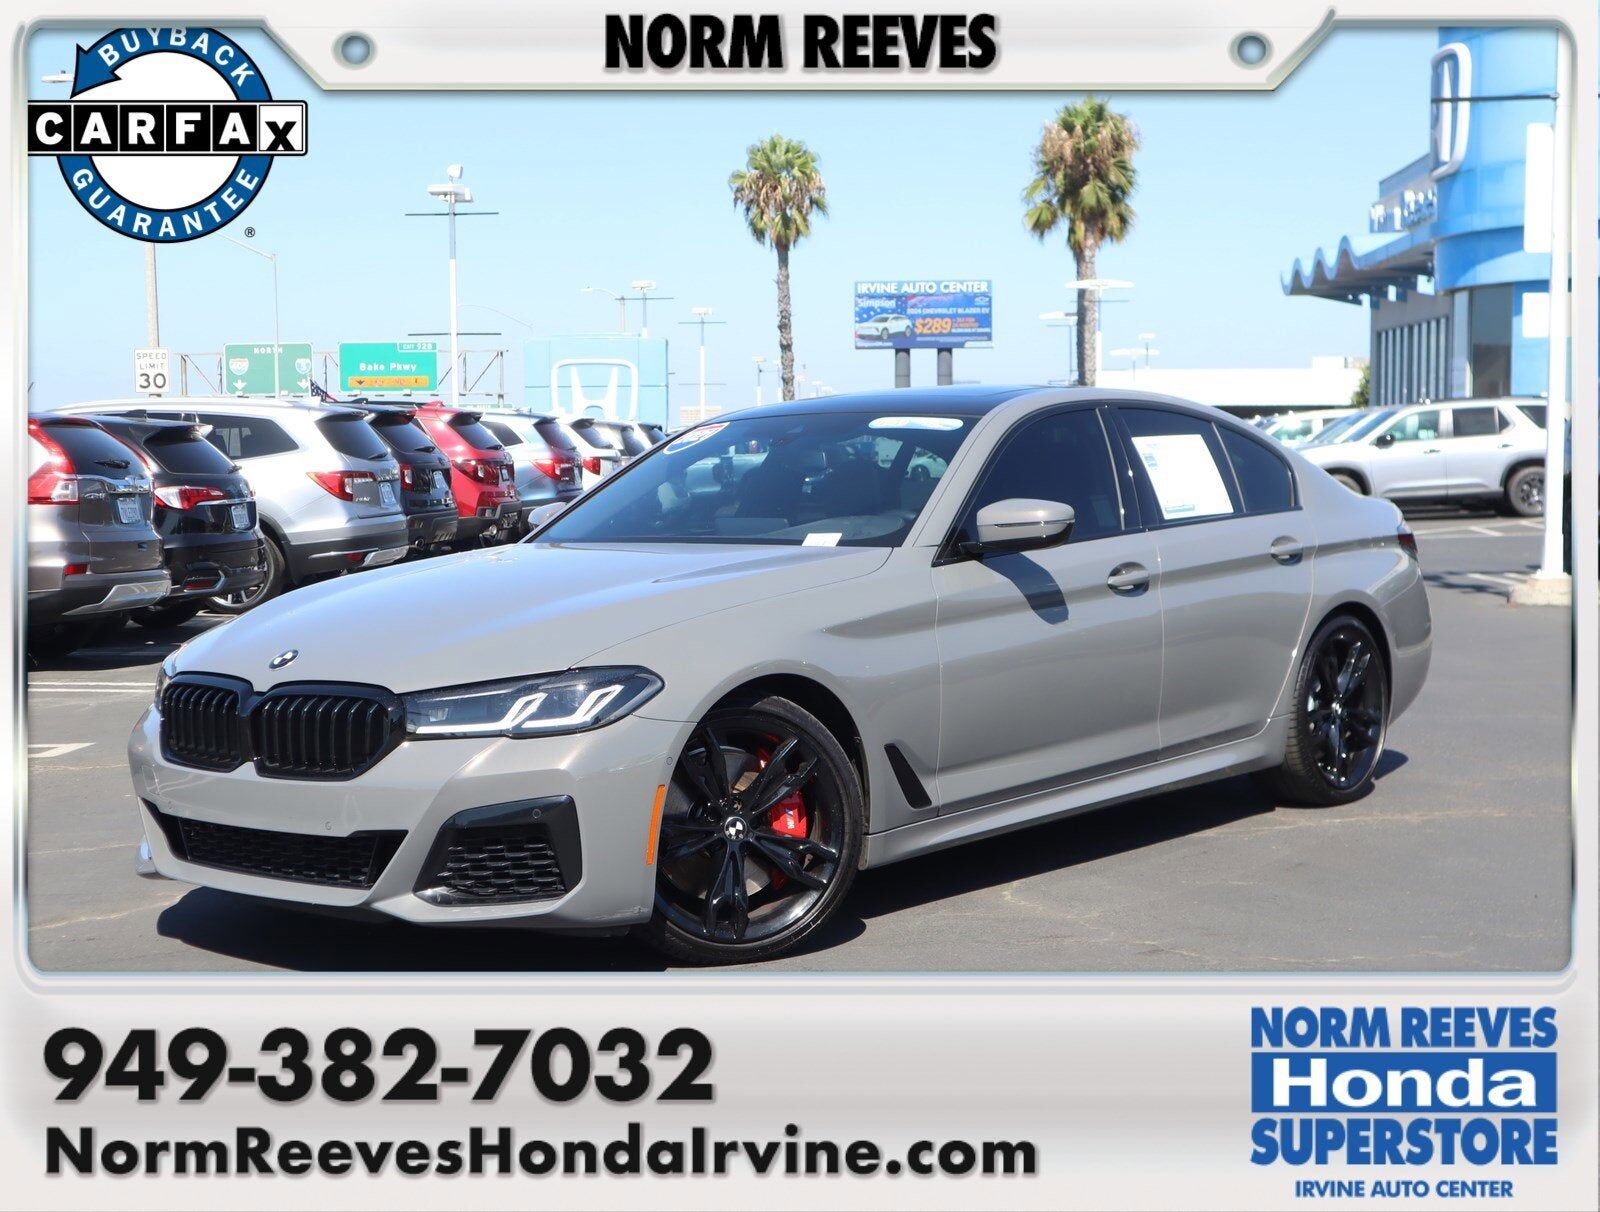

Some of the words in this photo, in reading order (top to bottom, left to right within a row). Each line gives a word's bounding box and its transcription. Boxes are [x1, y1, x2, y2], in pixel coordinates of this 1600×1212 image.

[857, 282, 898, 294] IRVINE
[901, 281, 937, 294] AUTO
[940, 281, 989, 293] CENTER
[857, 299, 896, 309] Simpson
[914, 317, 952, 335] $289
[136, 352, 167, 360] SPEED
[139, 362, 164, 370] LIMIT
[359, 362, 385, 372] Bake
[390, 362, 417, 372] Pkwy
[139, 372, 166, 389] 30
